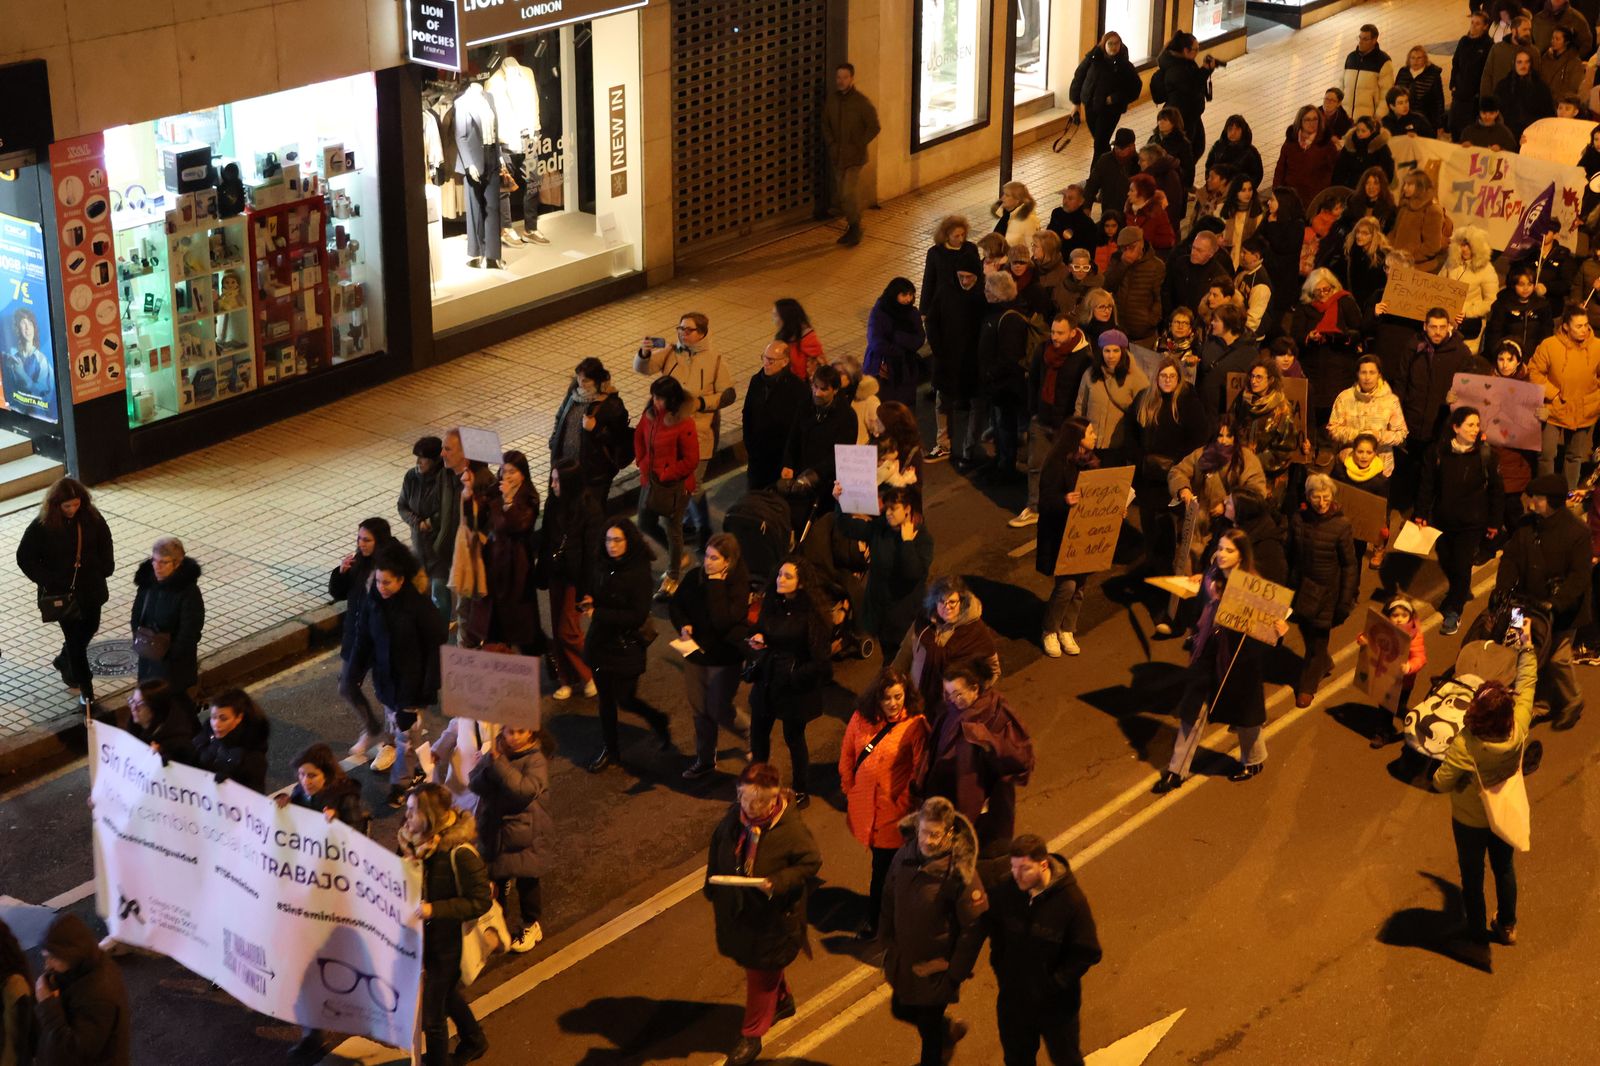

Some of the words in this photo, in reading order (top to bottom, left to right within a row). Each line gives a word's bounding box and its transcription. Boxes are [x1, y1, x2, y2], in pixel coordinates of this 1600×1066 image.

[421, 4, 444, 18] LION
[521, 0, 562, 19] LONDON
[426, 20, 440, 31] OF
[412, 30, 455, 48] PORCHES
[611, 89, 624, 111] IN
[525, 134, 552, 159] Día
[612, 118, 625, 167] NEW
[525, 152, 575, 180] Padre
[9, 278, 30, 300] 7€
[1411, 273, 1445, 291] FUTURO
[1392, 283, 1457, 309] FEMINISTA
[1080, 484, 1121, 504] Venga
[1068, 524, 1081, 539] la
[1084, 536, 1111, 555] solo
[1243, 576, 1261, 593] NO
[1262, 583, 1278, 601] ES
[100, 742, 120, 773] Sin
[121, 760, 213, 813] feminismo
[216, 799, 243, 824] no
[246, 804, 271, 845] hay
[273, 829, 360, 868] cambio
[362, 858, 408, 902] social
[137, 806, 200, 835] cambio
[261, 852, 351, 893] TRABAJO
[355, 881, 403, 925] SOCIAL
